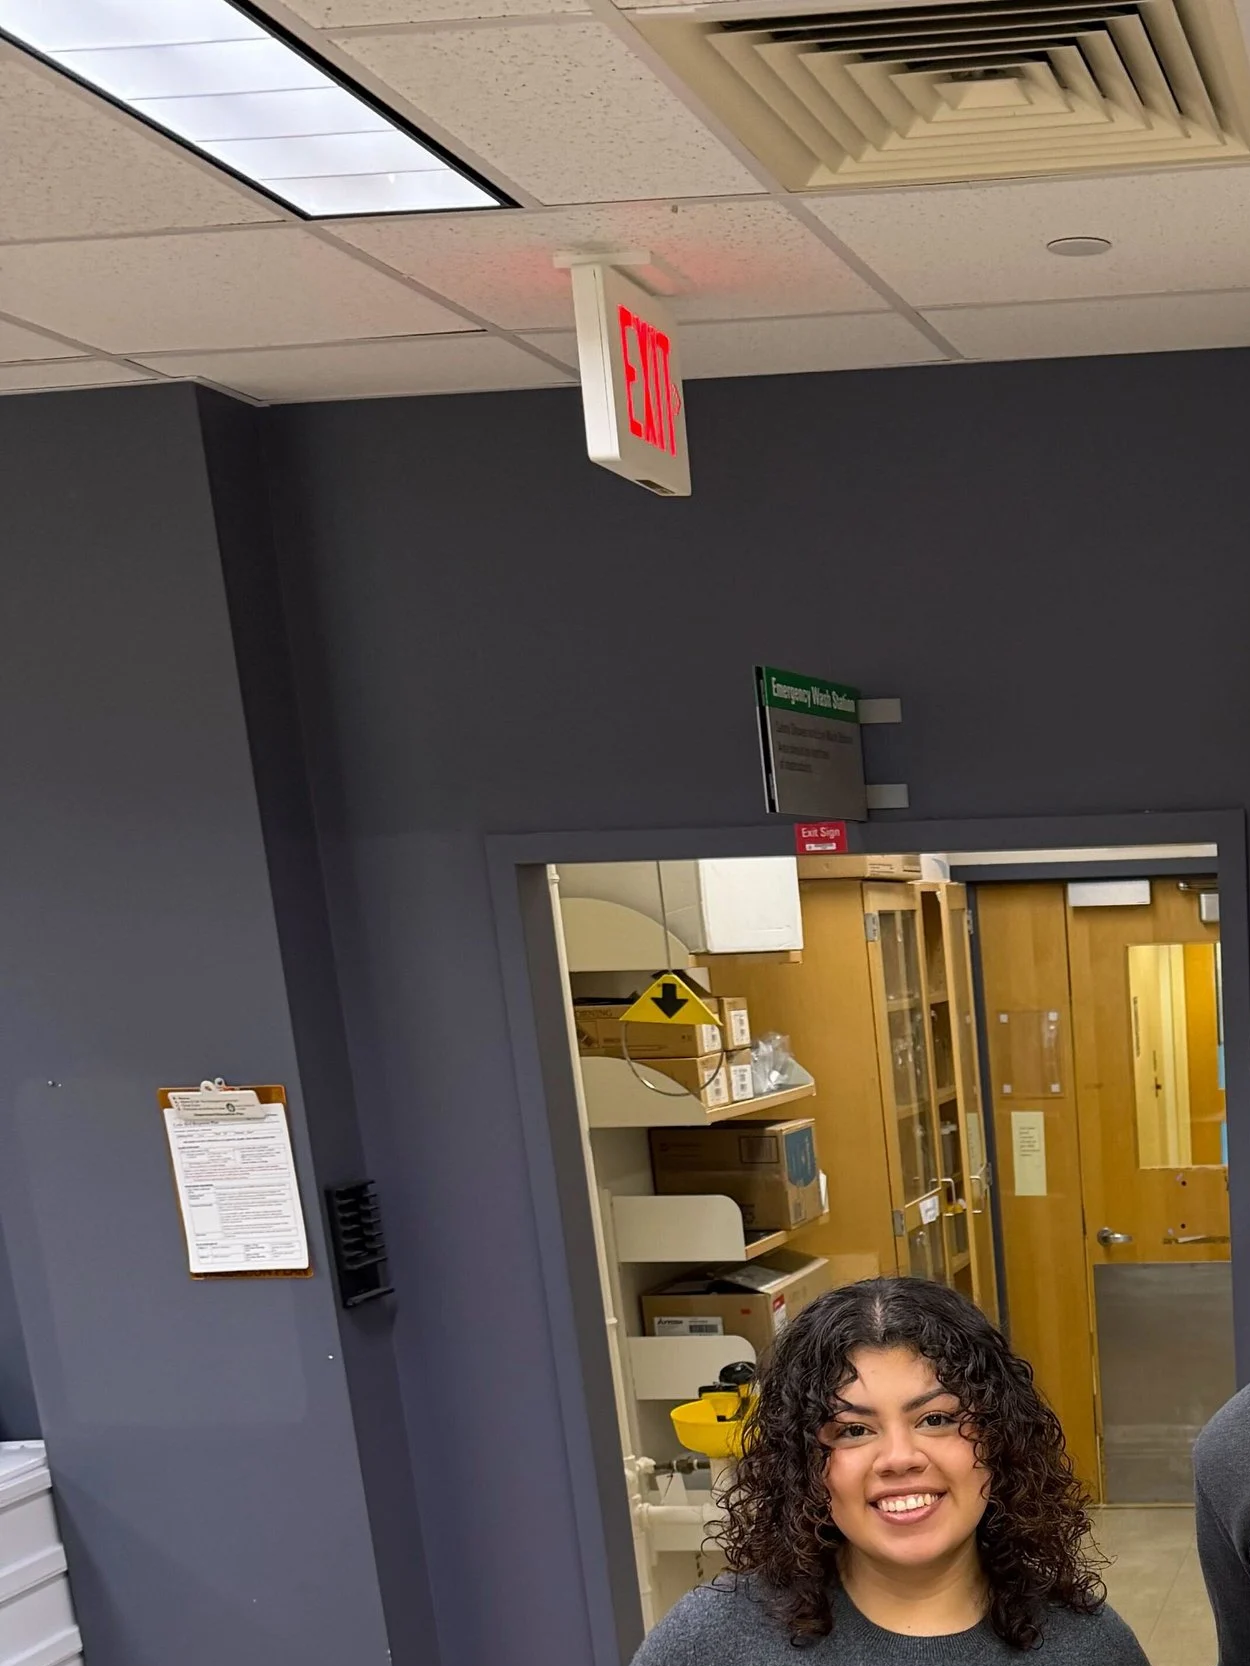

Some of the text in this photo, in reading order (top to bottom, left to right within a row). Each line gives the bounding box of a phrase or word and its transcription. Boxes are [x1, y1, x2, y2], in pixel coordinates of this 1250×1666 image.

[618, 304, 677, 457] EXIT
[771, 677, 856, 713] Emergency Wash Station
[801, 826, 840, 839] Exit Sign
